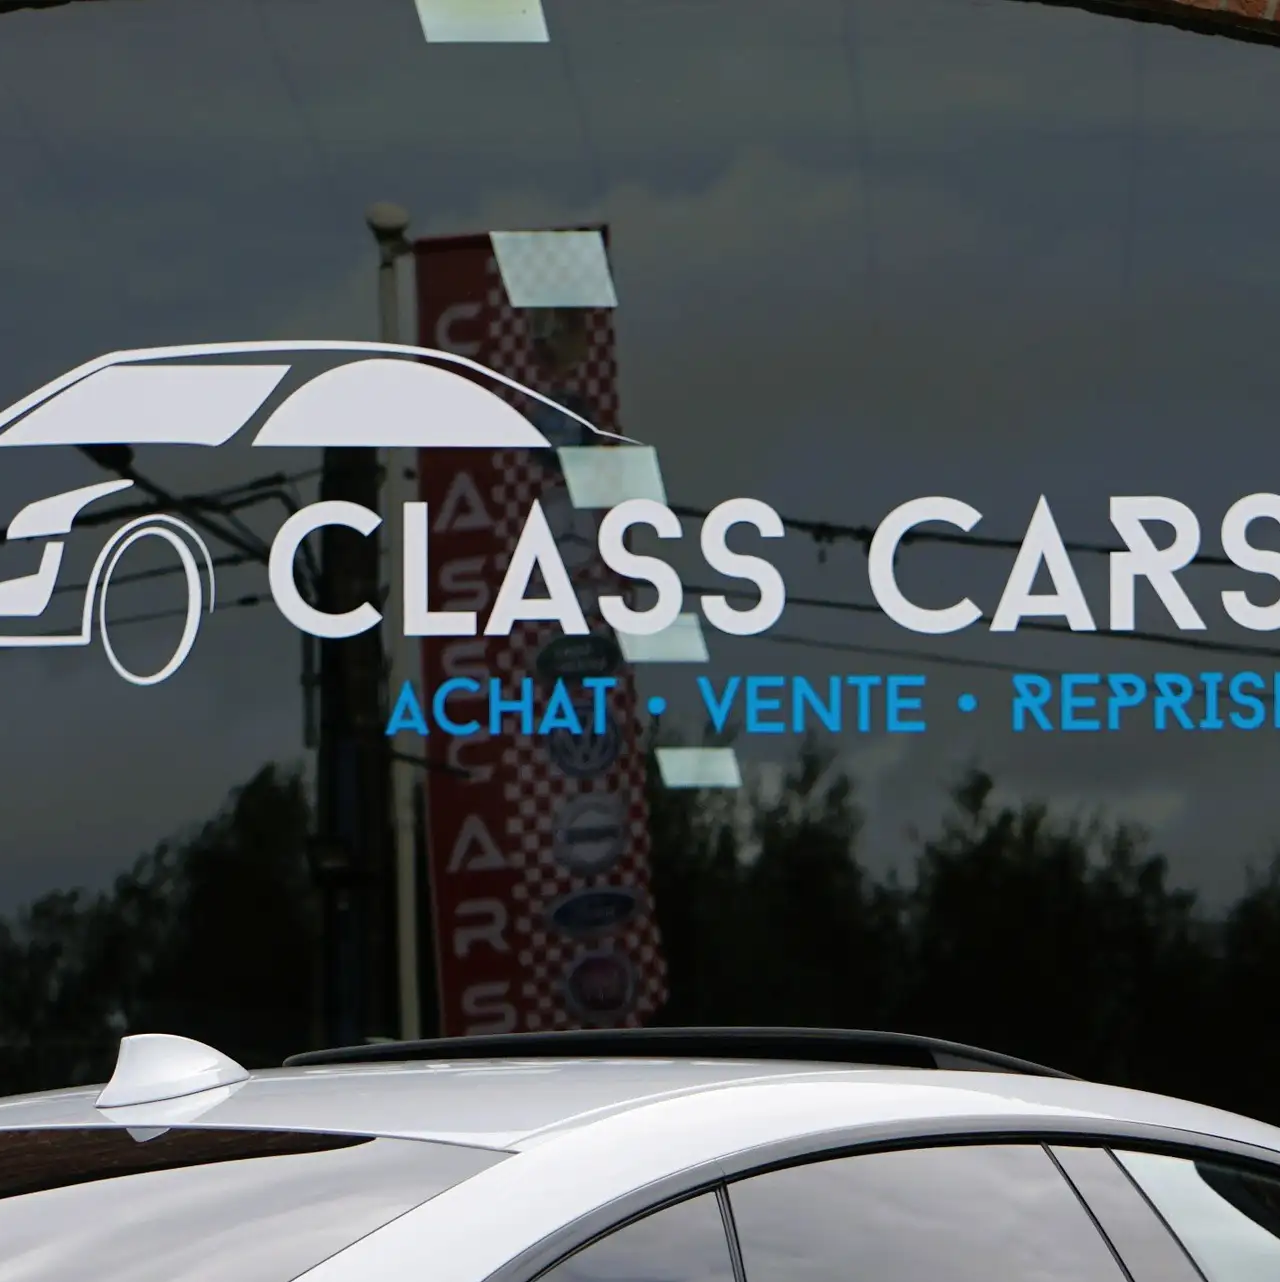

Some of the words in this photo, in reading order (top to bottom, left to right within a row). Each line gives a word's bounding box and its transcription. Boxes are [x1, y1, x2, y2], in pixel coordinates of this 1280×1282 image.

[269, 497, 784, 637] CLASS
[385, 677, 617, 737] ACHAT
[697, 674, 927, 735] VENTE
